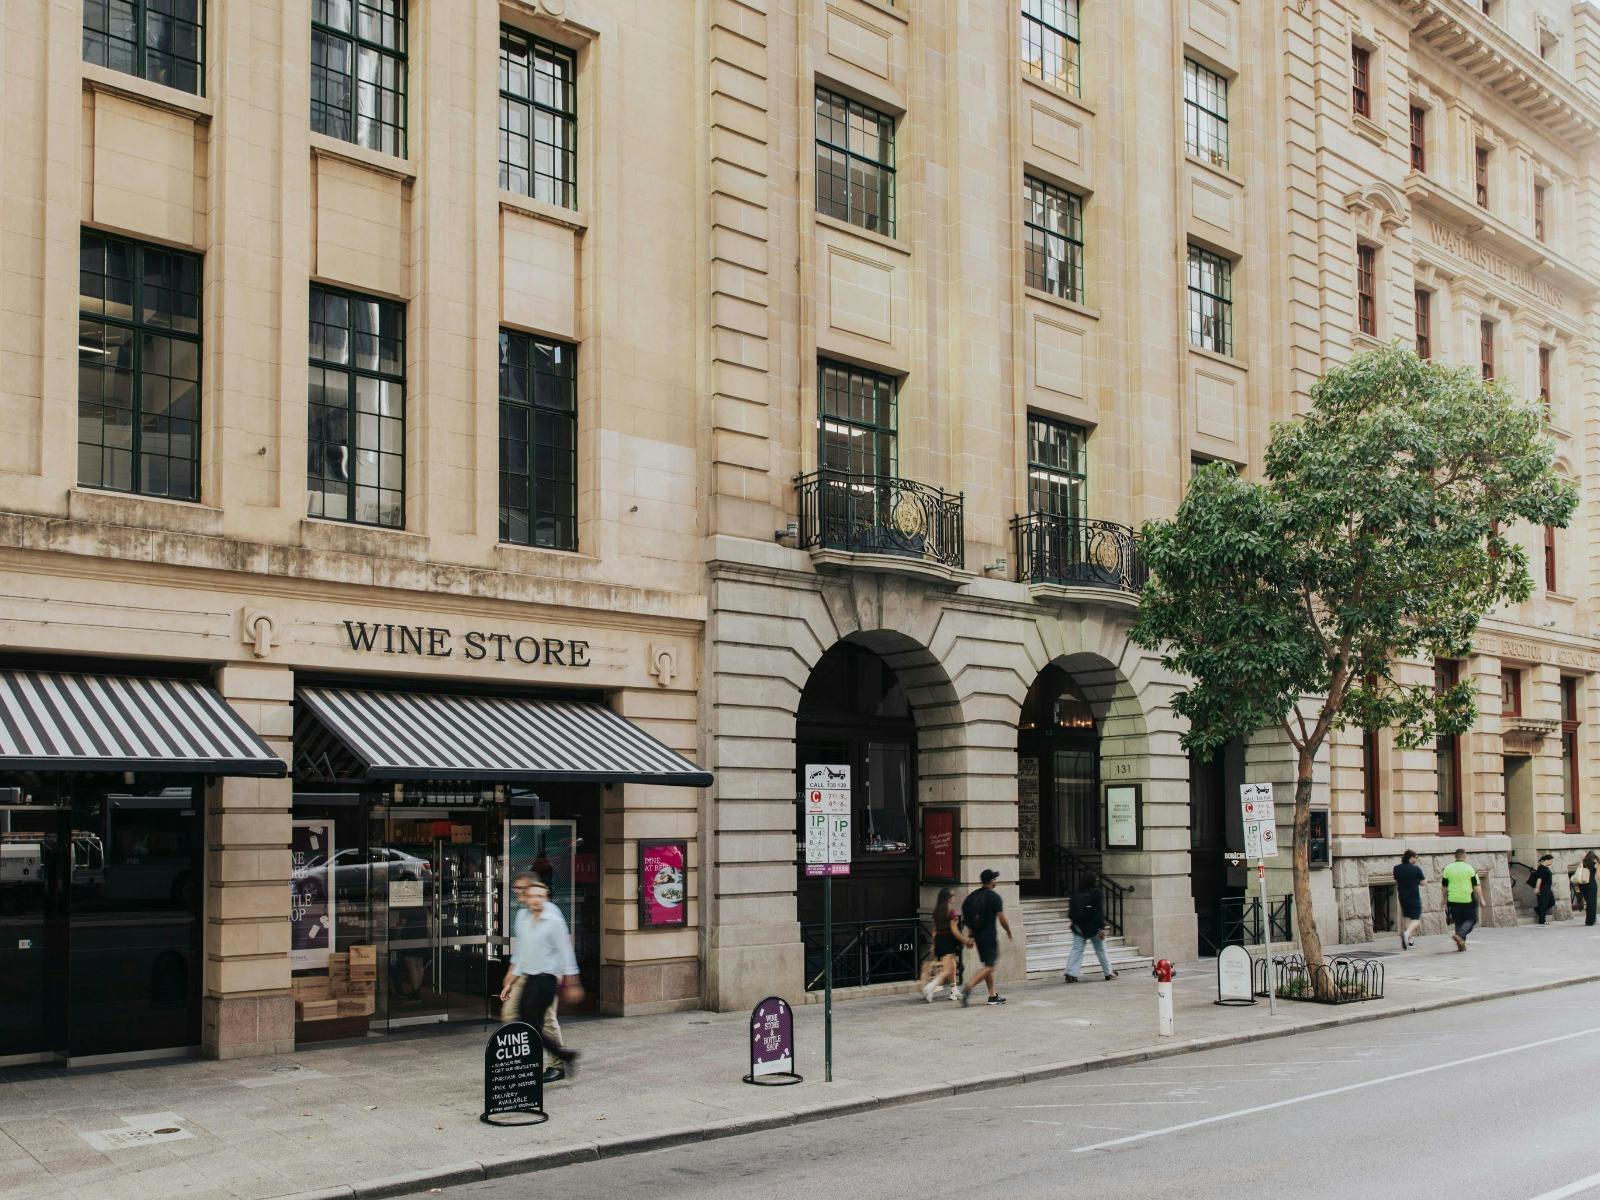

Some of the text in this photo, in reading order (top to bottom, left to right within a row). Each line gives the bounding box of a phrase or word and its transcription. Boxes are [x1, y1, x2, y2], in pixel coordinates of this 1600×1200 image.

[343, 620, 591, 667] WINE STORE
[1117, 764, 1131, 774] 131
[812, 815, 826, 827] 1P
[835, 820, 848, 832] 1P
[644, 857, 661, 865] DINE
[644, 864, 653, 872] AT
[766, 1013, 778, 1022] WINE
[496, 1031, 529, 1047] WINE
[763, 1035, 781, 1045] BOTTLE
[495, 1044, 531, 1060] CLUB
[498, 1096, 527, 1106] AVAILABLE
